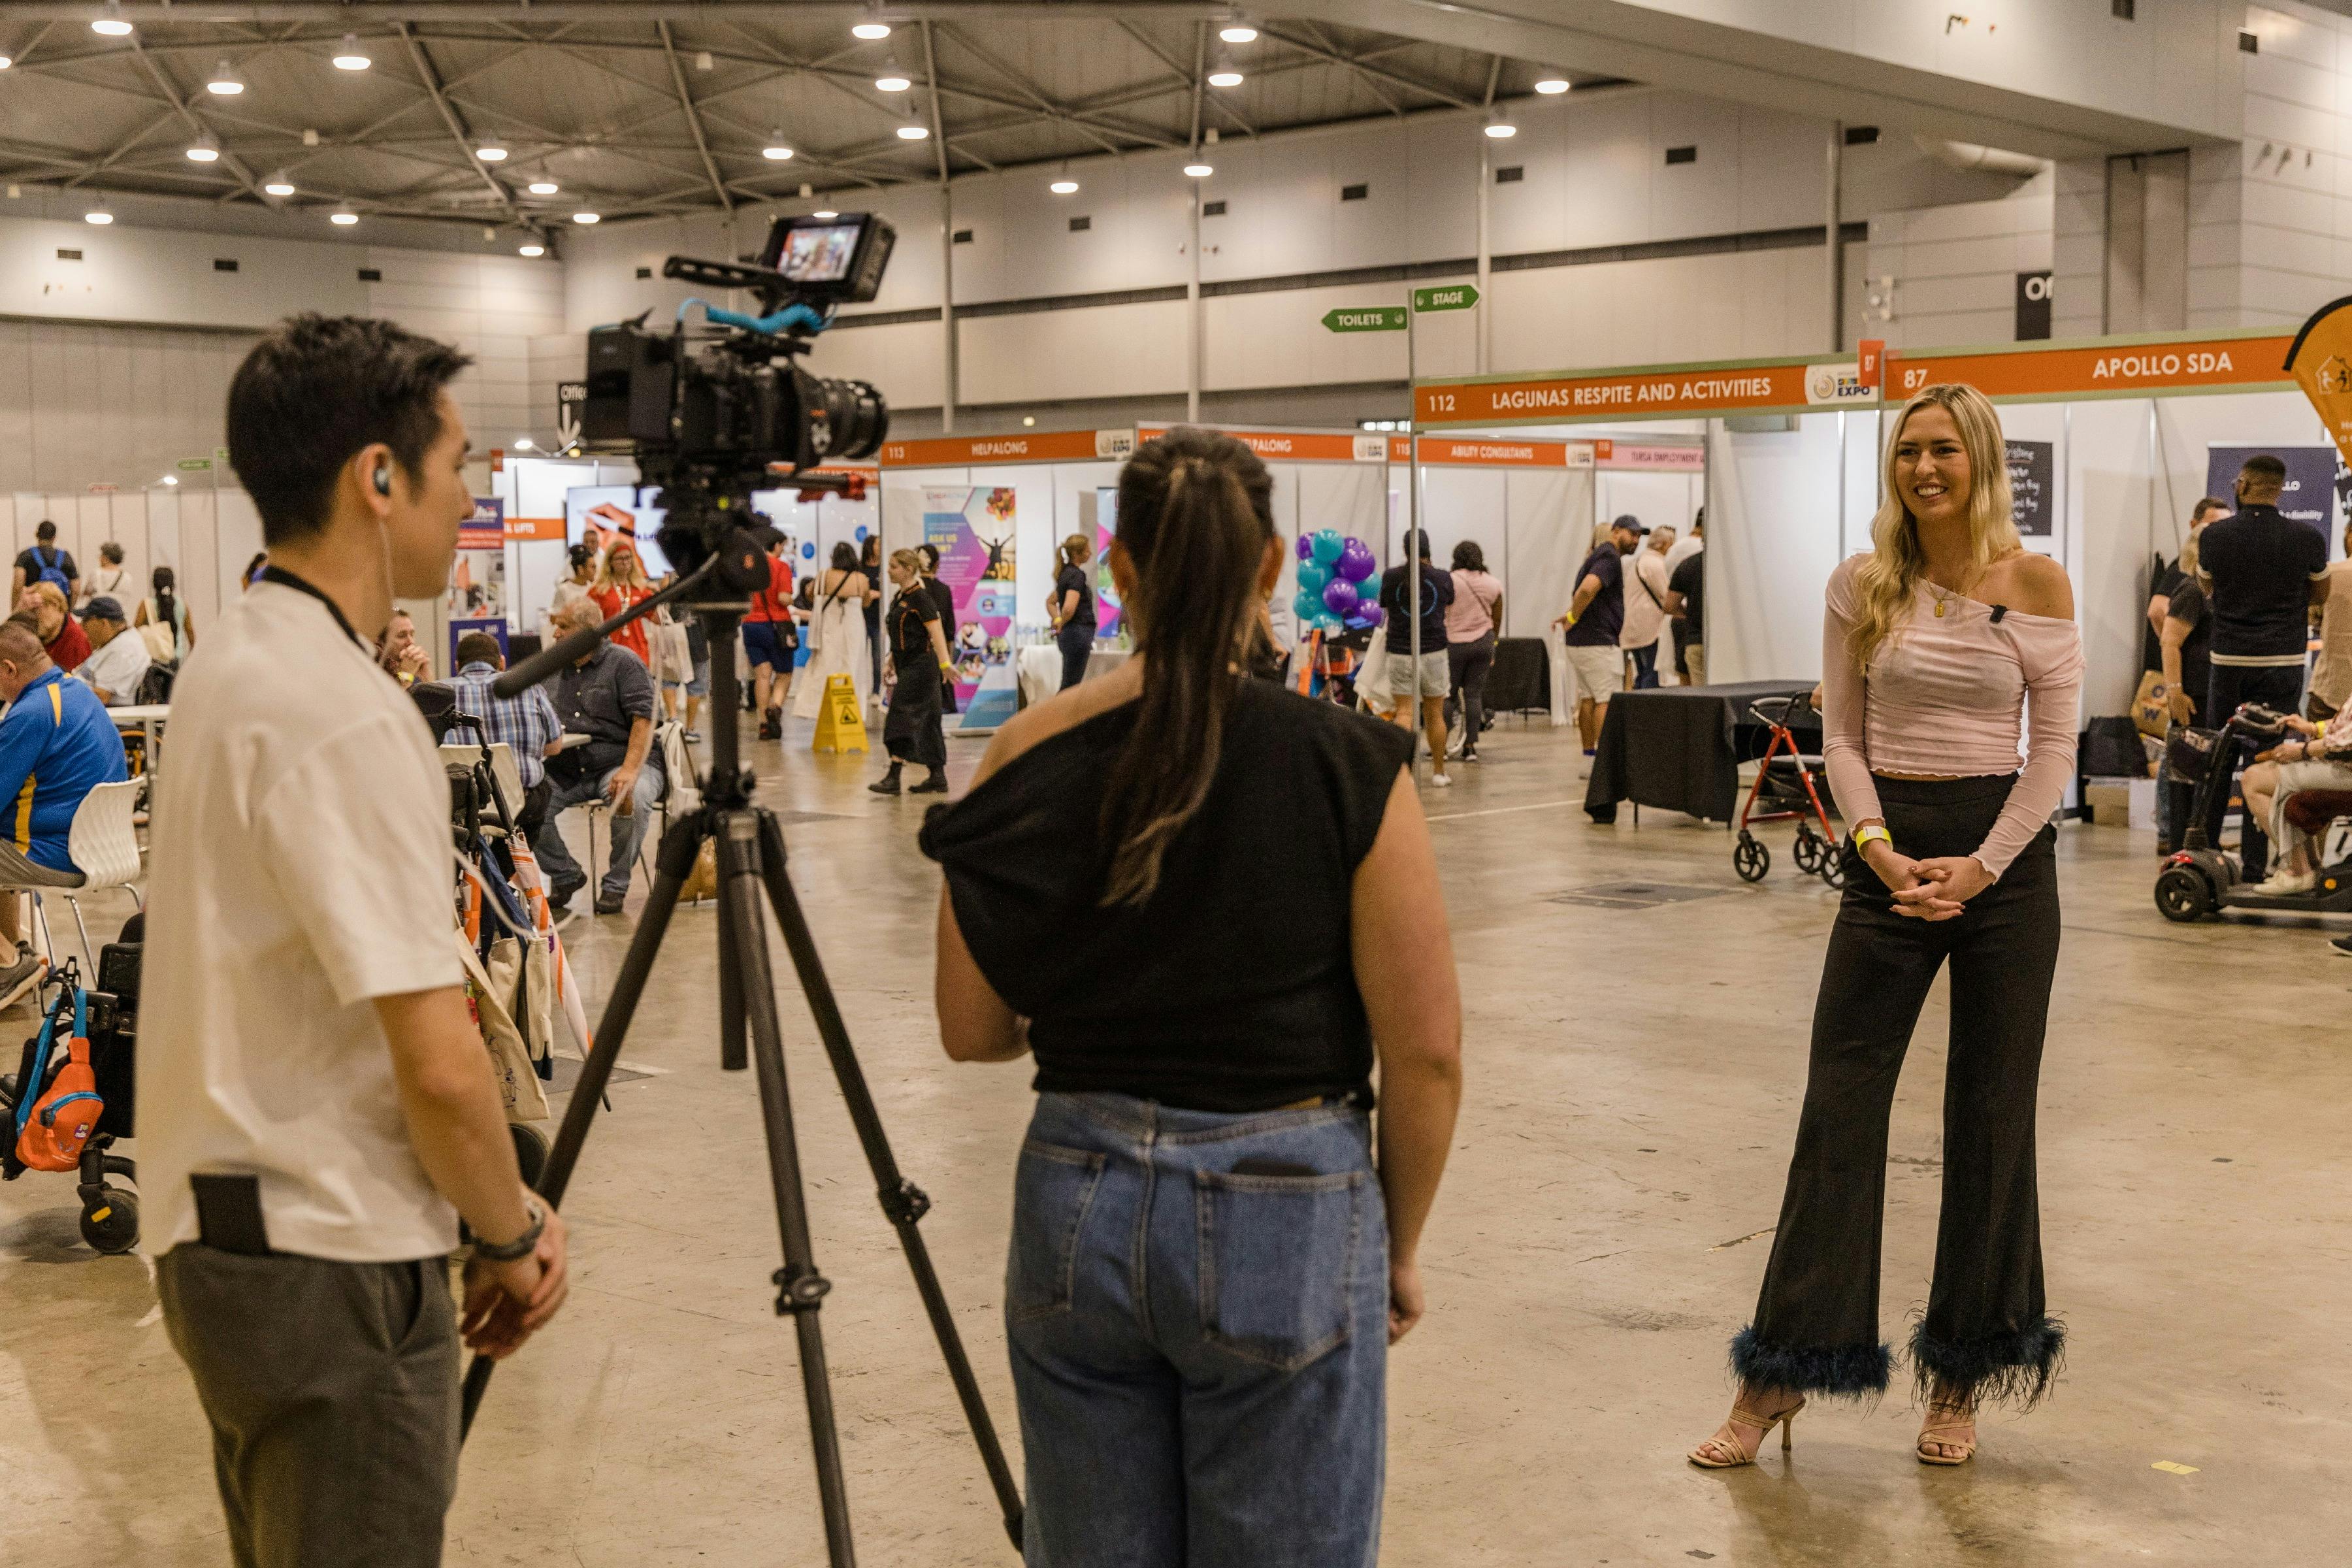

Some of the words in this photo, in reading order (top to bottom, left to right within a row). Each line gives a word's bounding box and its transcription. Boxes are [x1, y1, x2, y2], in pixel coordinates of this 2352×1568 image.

[1432, 291, 1463, 305] STAGE
[1337, 314, 1383, 326] TOILETS
[1865, 355, 1875, 372] 87
[2092, 355, 2181, 379] APOLLO
[2187, 351, 2233, 374] SDA
[1904, 368, 1927, 388] 87
[1429, 394, 1456, 412] 112
[1492, 388, 1569, 410] LAGUNAS
[1574, 385, 1632, 406] RESPITE
[1637, 383, 1676, 402] AND
[1680, 377, 1772, 400] ACTIVITIES
[1838, 386, 1870, 397] EXPO
[889, 446, 905, 459] 113
[972, 441, 1028, 456] HELPALONG
[1451, 445, 1479, 457] ABILITY
[1480, 446, 1533, 459] CONSULTANTS
